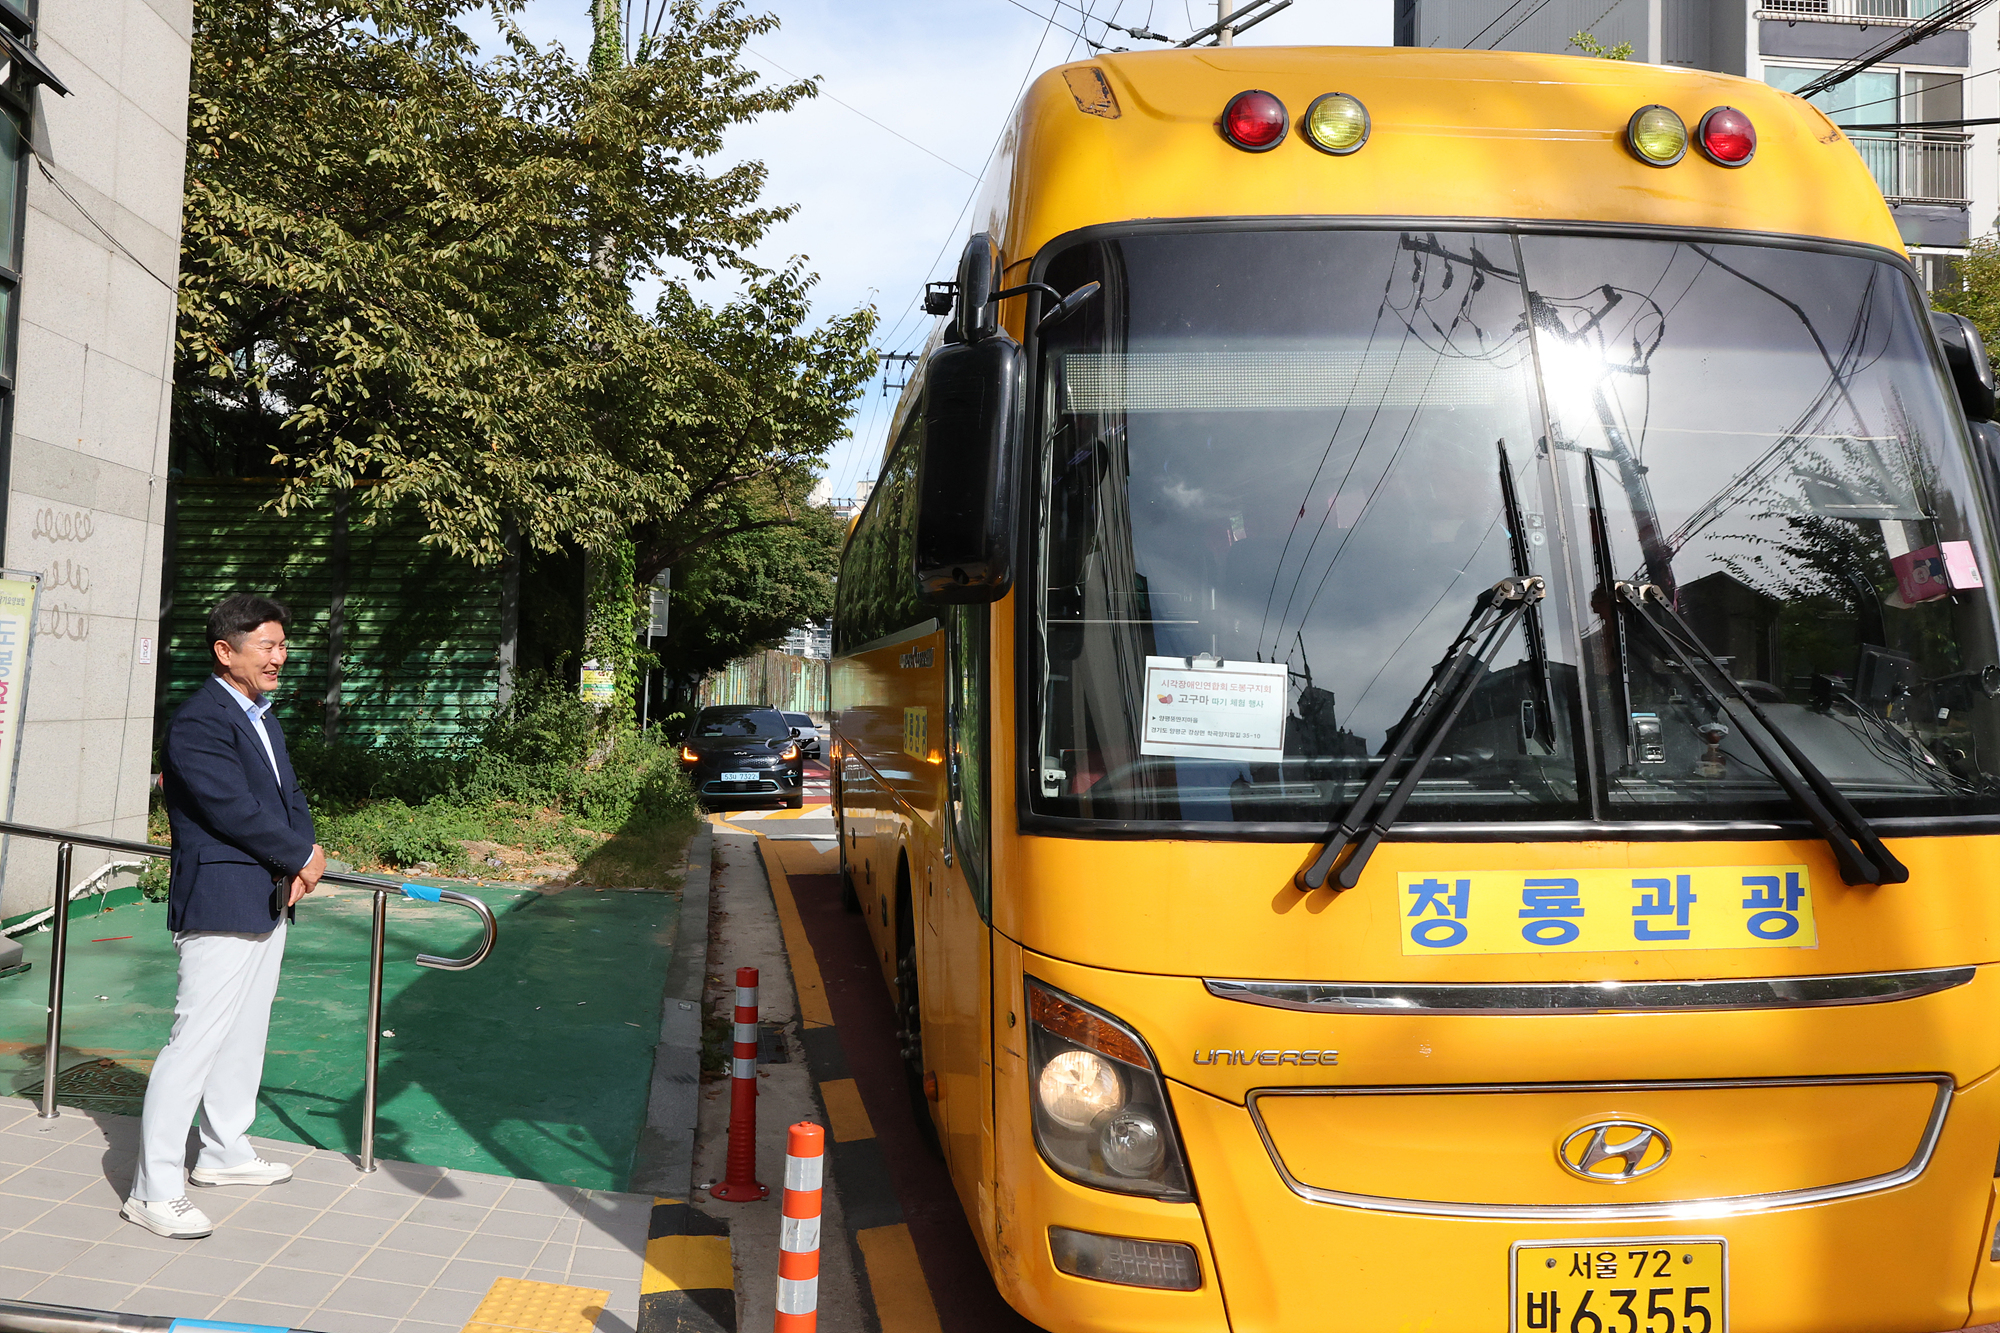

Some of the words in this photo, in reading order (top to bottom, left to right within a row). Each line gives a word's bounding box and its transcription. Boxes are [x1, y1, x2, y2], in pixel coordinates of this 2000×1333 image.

[1161, 679, 1228, 691] 시각장애인연합회
[1230, 683, 1272, 693] 도봉구지회
[1178, 694, 1209, 705] 고구마
[1211, 697, 1228, 706] 따기
[1230, 699, 1246, 707] 체험
[1249, 699, 1264, 708] 행사
[1194, 1049, 1338, 1065] UNIVERSE
[1569, 1250, 1618, 1279] 서울
[1628, 1249, 1672, 1278] 72
[1527, 1290, 1561, 1333] 바
[1570, 1286, 1712, 1333] 6355
